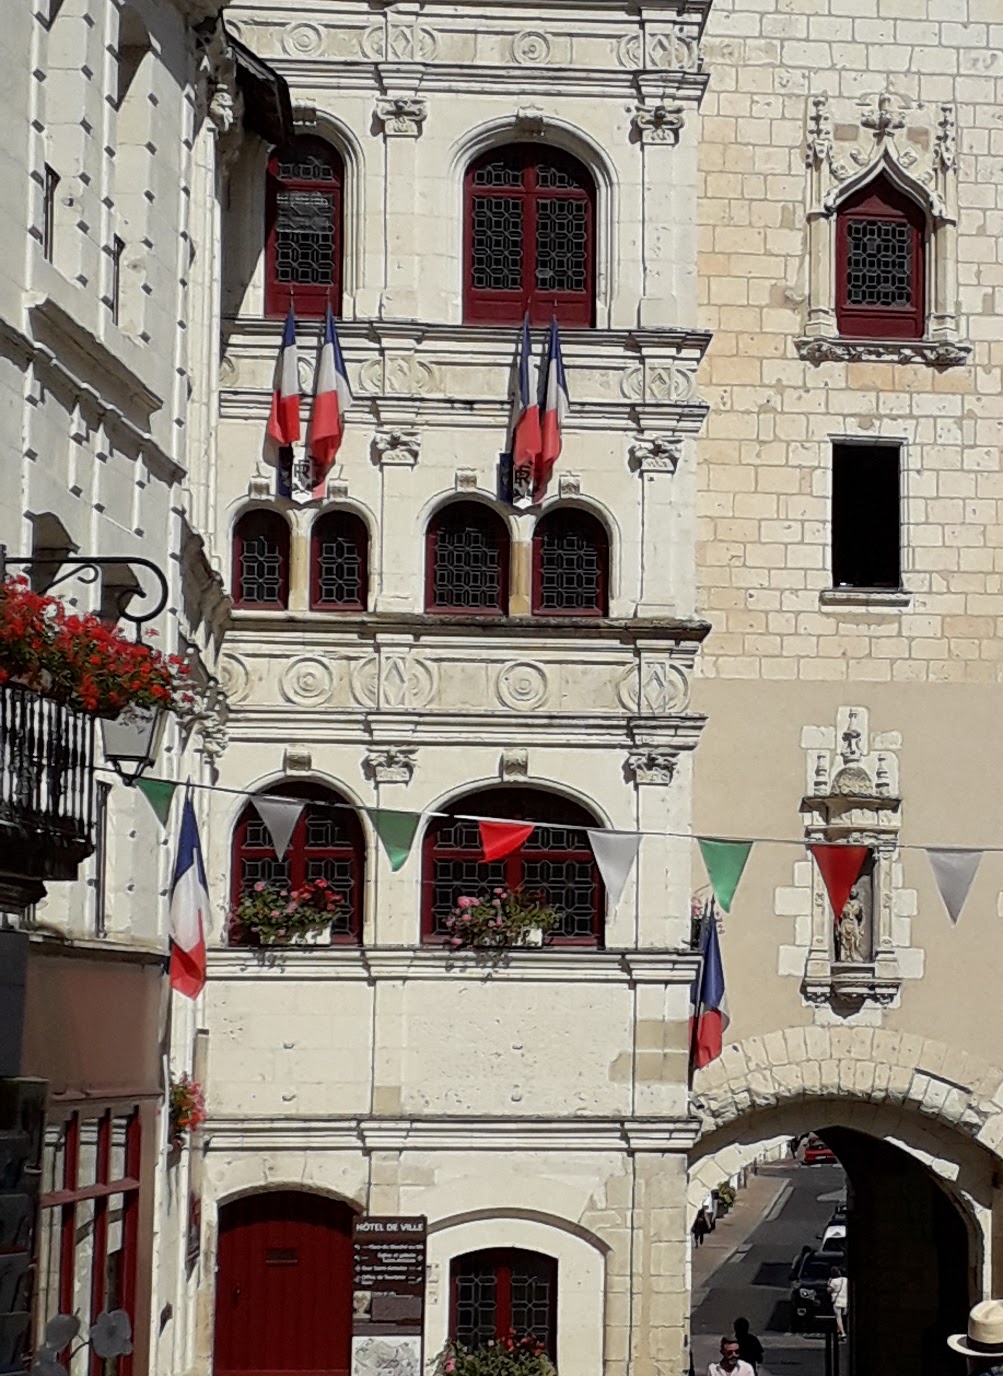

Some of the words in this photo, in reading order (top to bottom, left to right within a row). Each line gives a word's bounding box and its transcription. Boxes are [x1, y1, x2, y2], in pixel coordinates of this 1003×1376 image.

[356, 1221, 385, 1232] HÔTEL
[386, 1223, 398, 1232] DE
[399, 1223, 424, 1232] VILLE
